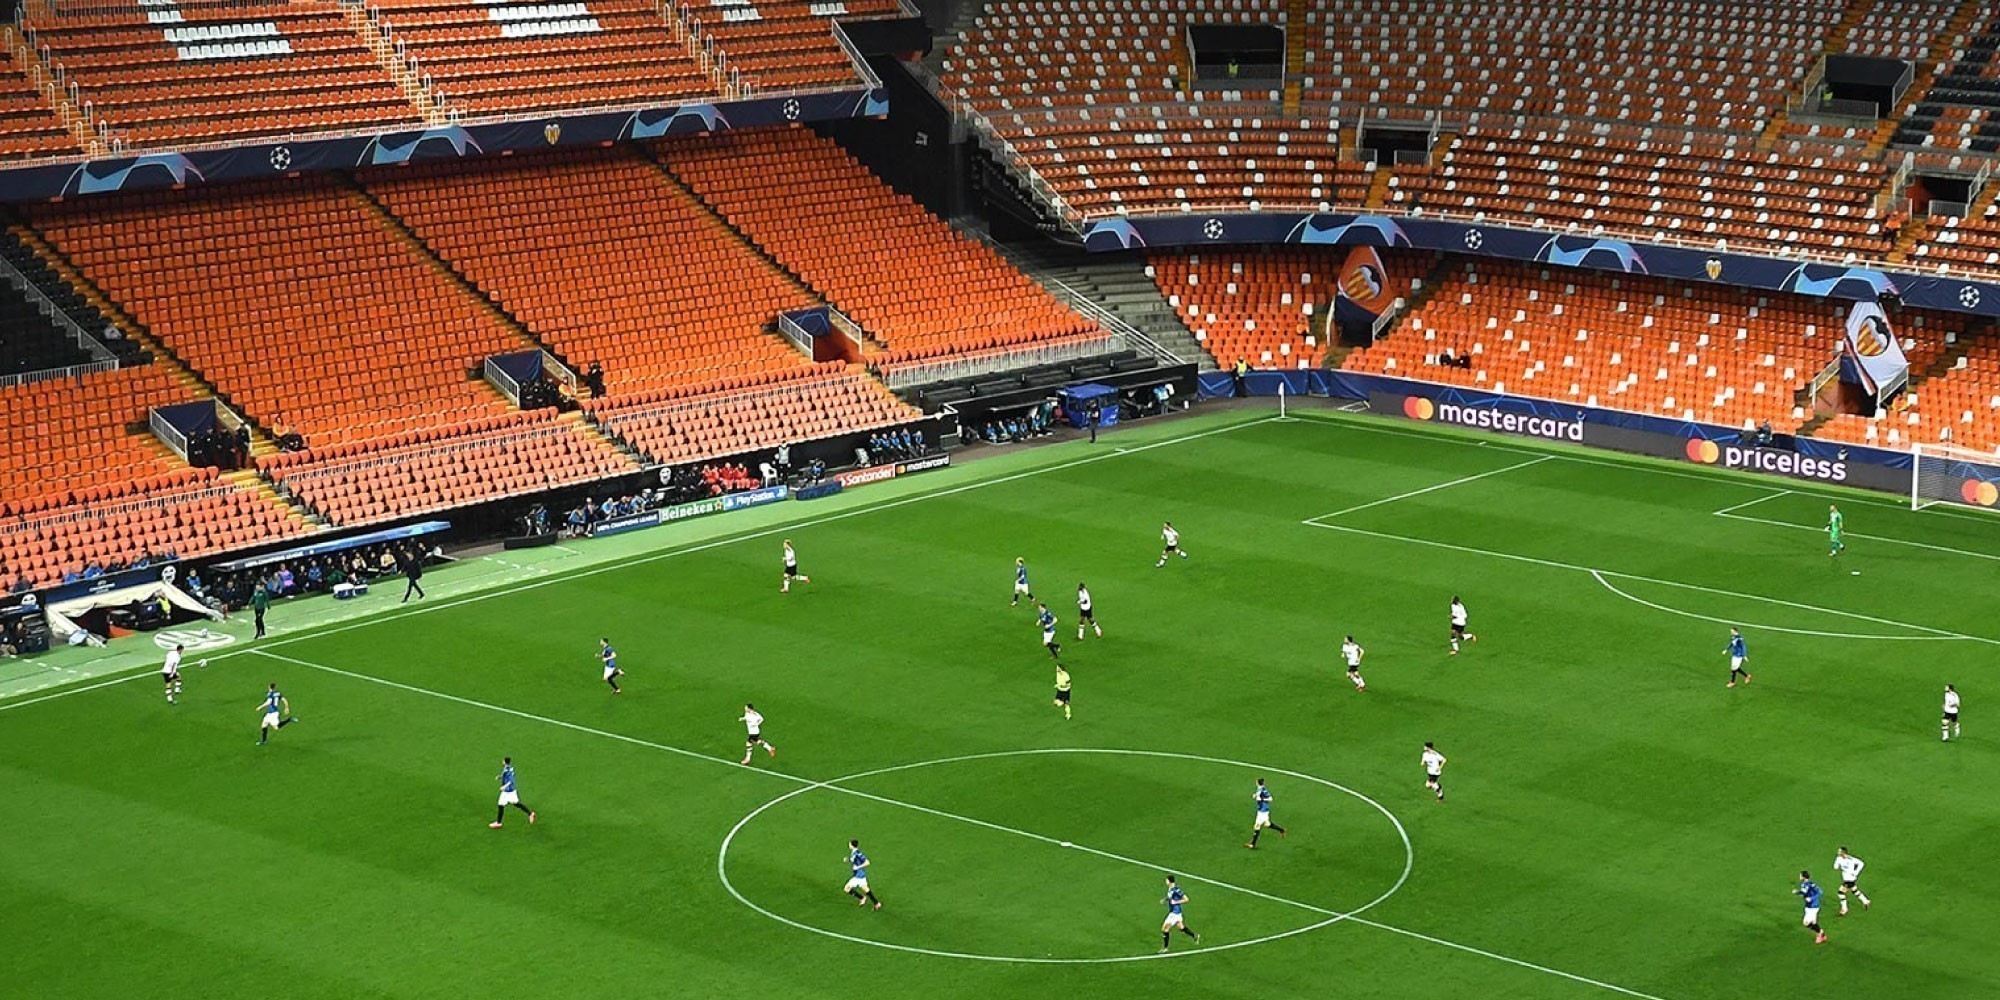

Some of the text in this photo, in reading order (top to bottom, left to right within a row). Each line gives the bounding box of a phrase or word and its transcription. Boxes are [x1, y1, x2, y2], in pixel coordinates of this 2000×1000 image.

[1439, 403, 1584, 441] mastercard
[906, 455, 949, 471] mastercard
[1725, 446, 1847, 480] priceless
[845, 468, 894, 486] Santander
[736, 491, 775, 506] PlayStation
[661, 503, 713, 521] Heineken
